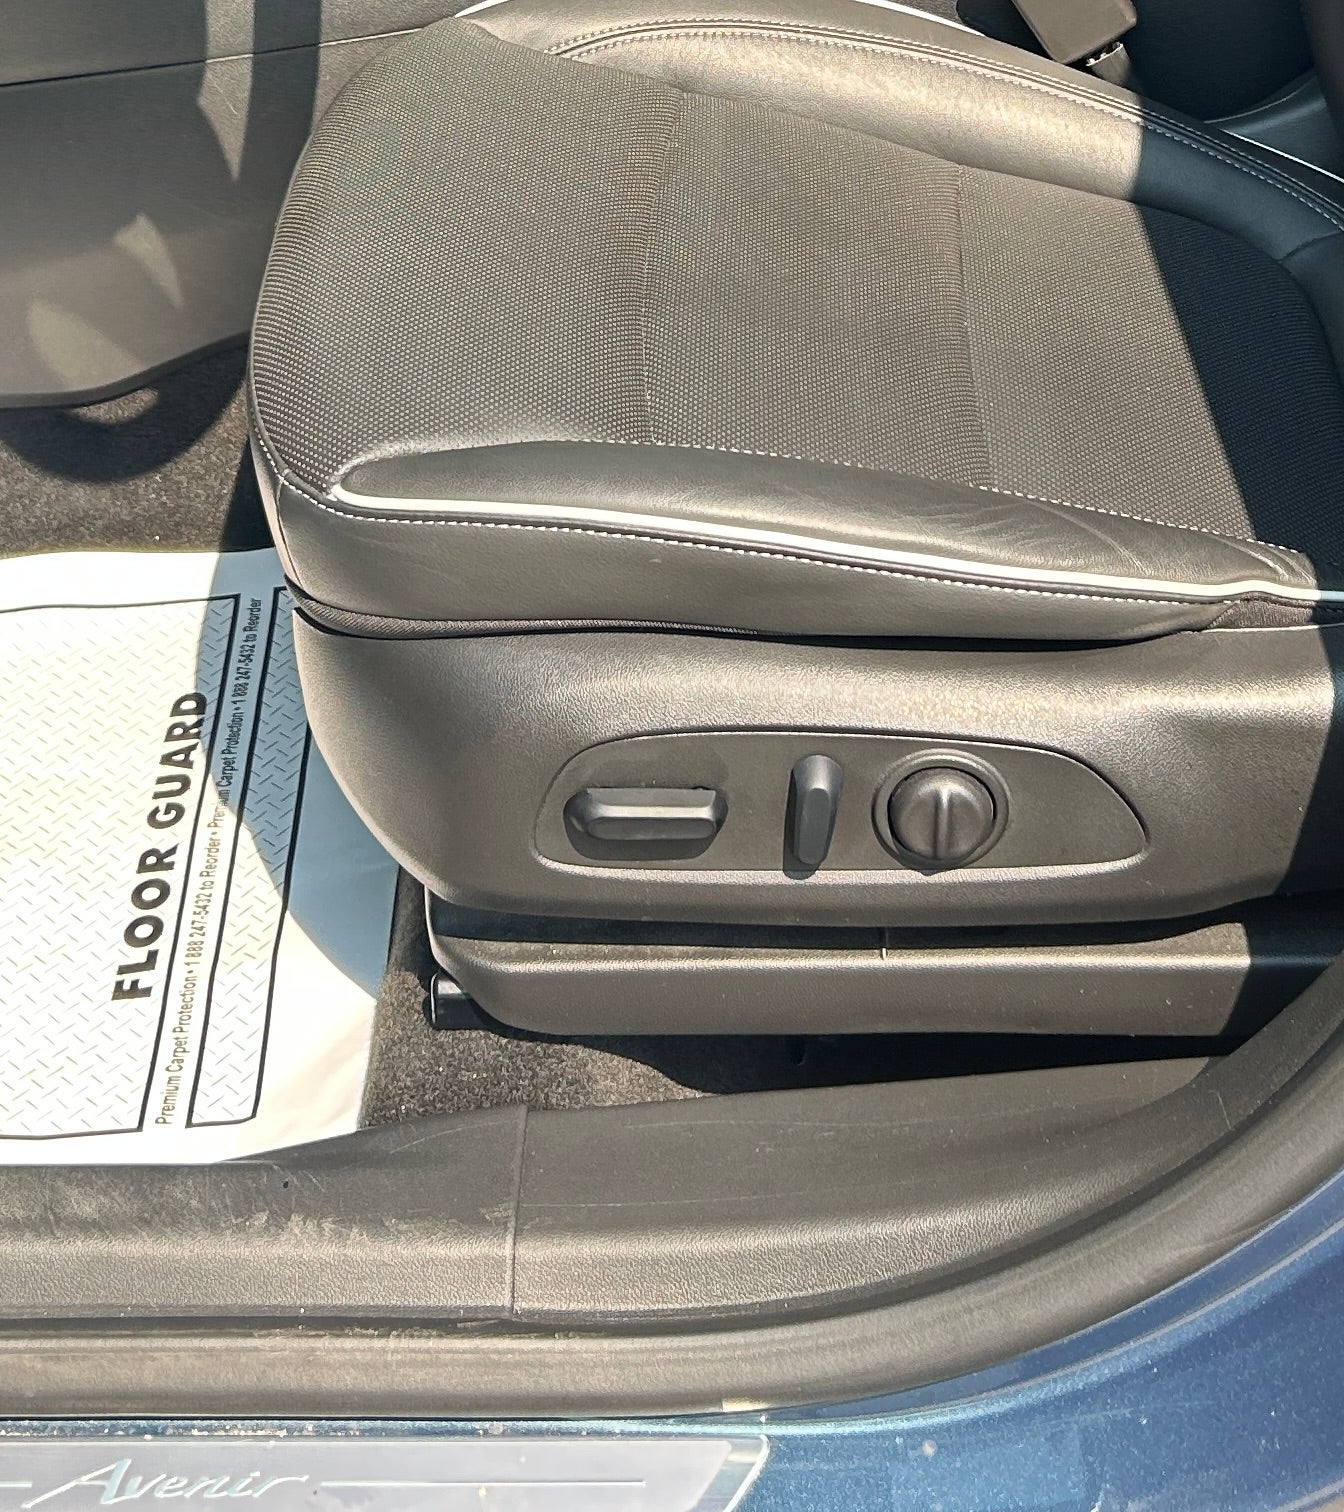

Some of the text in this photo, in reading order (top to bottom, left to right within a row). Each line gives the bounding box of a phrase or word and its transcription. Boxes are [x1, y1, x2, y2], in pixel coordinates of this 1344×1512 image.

[242, 598, 261, 632] Reorder
[243, 634, 257, 642] to
[221, 712, 244, 754] Protection
[216, 757, 238, 787] Carpet
[111, 692, 207, 1001] FLOOR GUARD
[199, 837, 221, 877] Reorder
[199, 881, 214, 890] to
[189, 893, 212, 937] 247-5432
[185, 941, 204, 958] 888
[172, 976, 197, 1033] Protection
[165, 1037, 190, 1072] Carpet
[155, 1076, 181, 1124] Premium
[21, 1459, 309, 1508] Avenir
